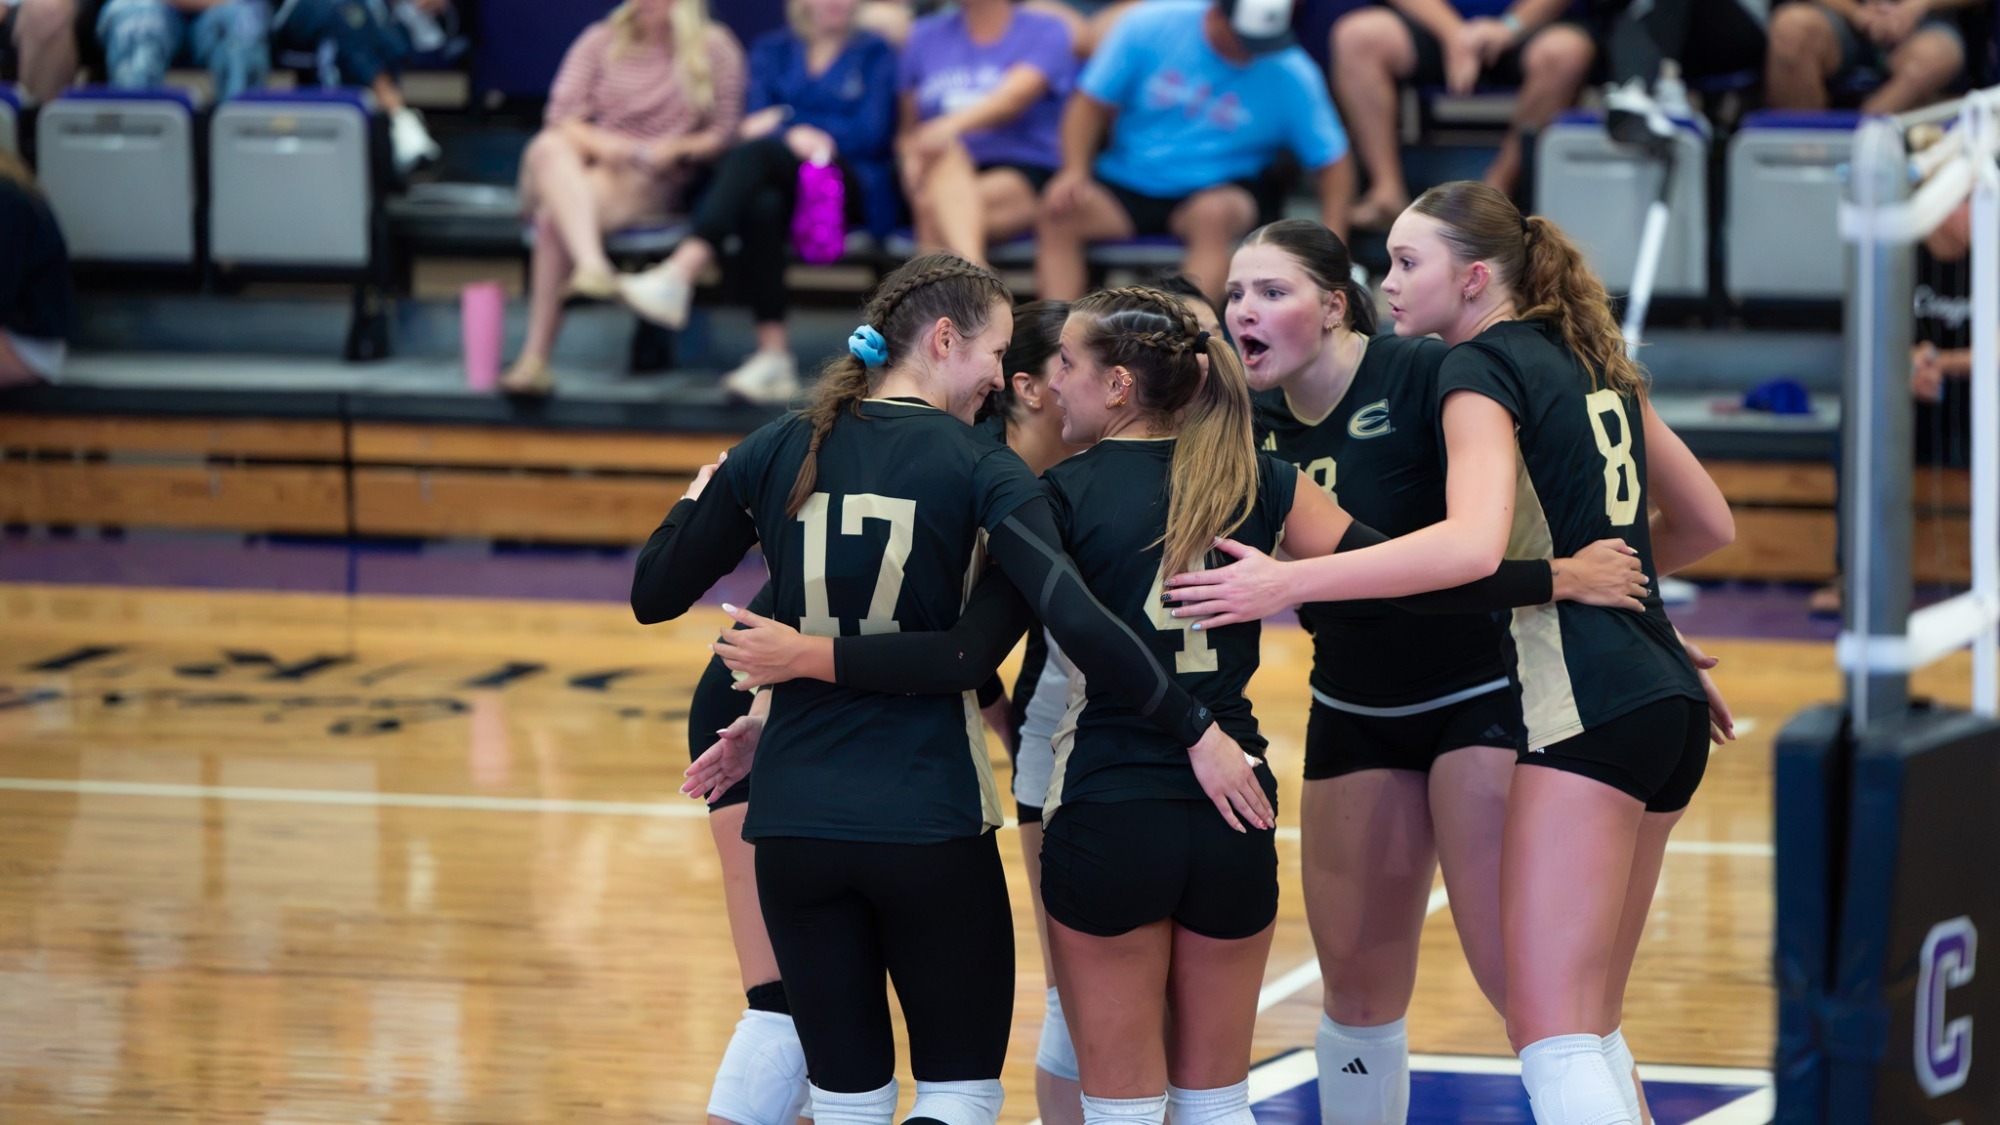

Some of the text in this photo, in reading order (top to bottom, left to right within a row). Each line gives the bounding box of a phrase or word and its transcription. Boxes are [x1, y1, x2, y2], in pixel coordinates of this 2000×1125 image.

[1585, 388, 1641, 526] 8
[796, 491, 917, 638] 17
[1143, 548, 1218, 674] 4
[1913, 914, 1978, 1098] C
